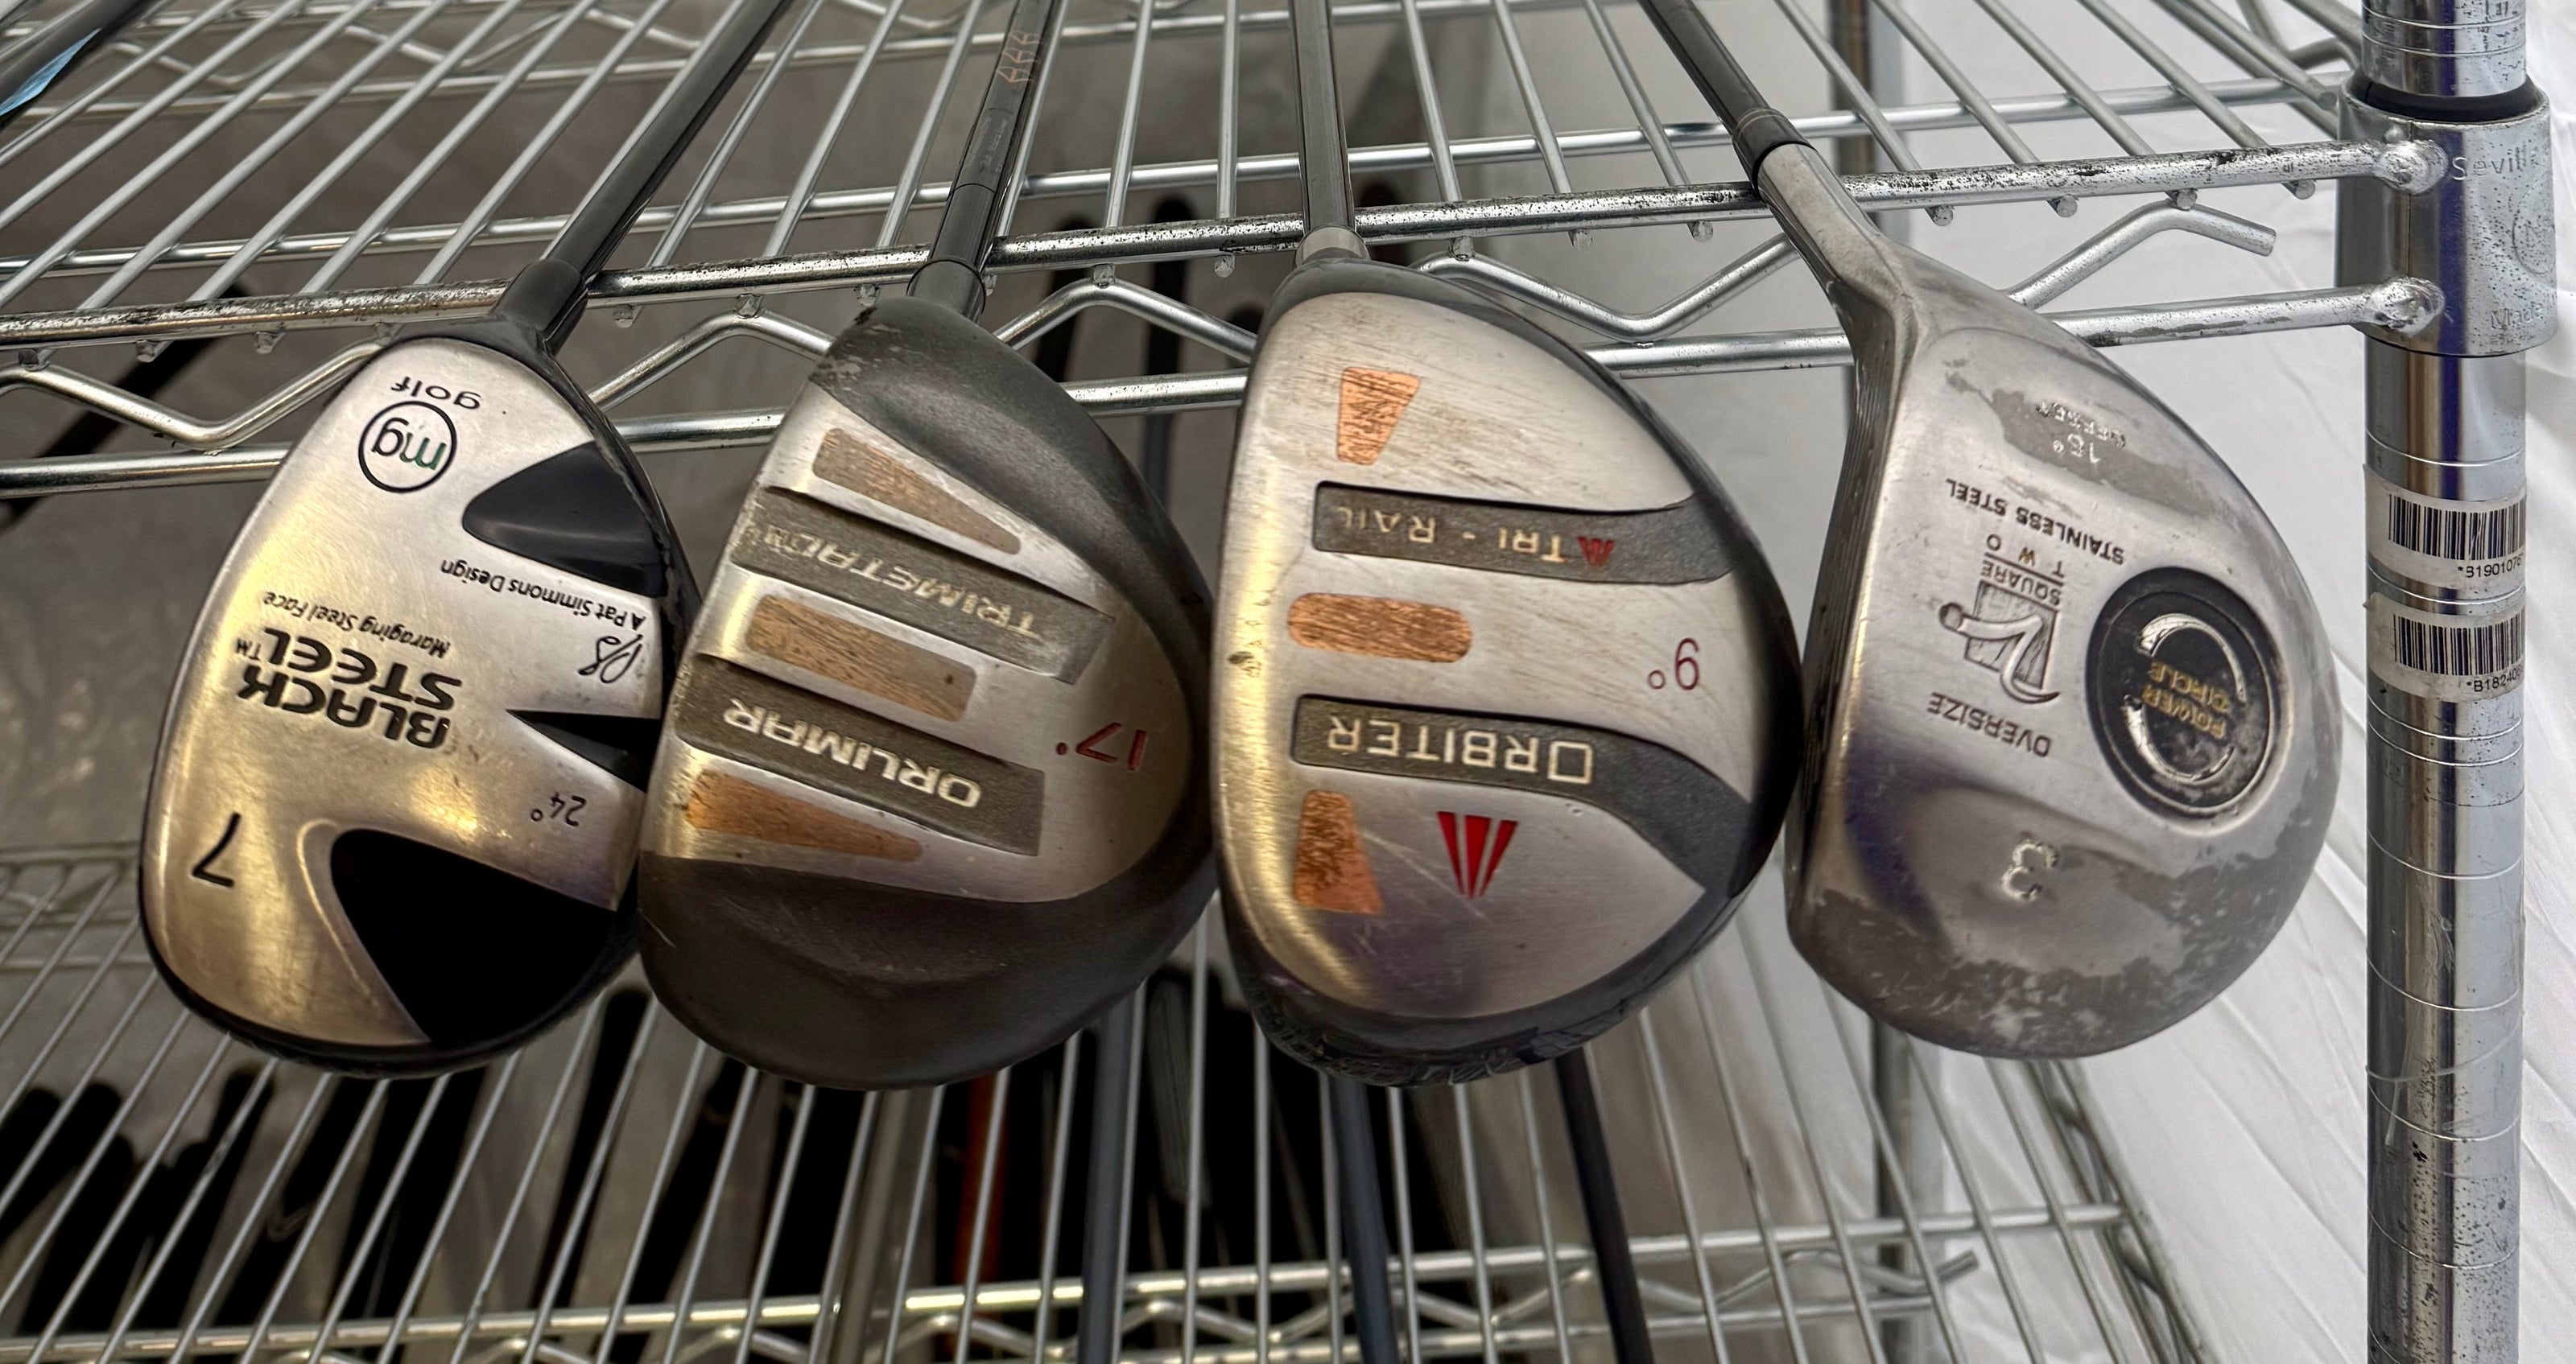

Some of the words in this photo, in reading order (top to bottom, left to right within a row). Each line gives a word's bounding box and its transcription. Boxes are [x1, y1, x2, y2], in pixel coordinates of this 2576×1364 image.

[391, 375, 481, 410] golf
[371, 416, 448, 471] mg
[1946, 478, 2006, 516] STEEL
[1337, 506, 1436, 544] RAIL
[1498, 526, 1568, 563] TRI
[2016, 506, 2126, 566] STAINLESS
[441, 558, 505, 592] Design
[1980, 558, 2062, 607] SQUARE
[265, 591, 306, 617] Face
[509, 579, 592, 616] Simmons
[597, 602, 625, 626] Pat
[310, 605, 358, 633] Steel
[362, 616, 451, 658] Maraging
[629, 614, 646, 630] A
[237, 665, 451, 750] BLACK
[2149, 660, 2232, 713] CIRCLE
[1926, 690, 2053, 759] OVERSIZE
[2141, 684, 2227, 740] POWER
[723, 698, 982, 809] ORLIMAR
[1327, 714, 1594, 785] ORBITER
[530, 792, 588, 828] 24°
[192, 812, 241, 888] 7
[2000, 838, 2058, 901] 3
